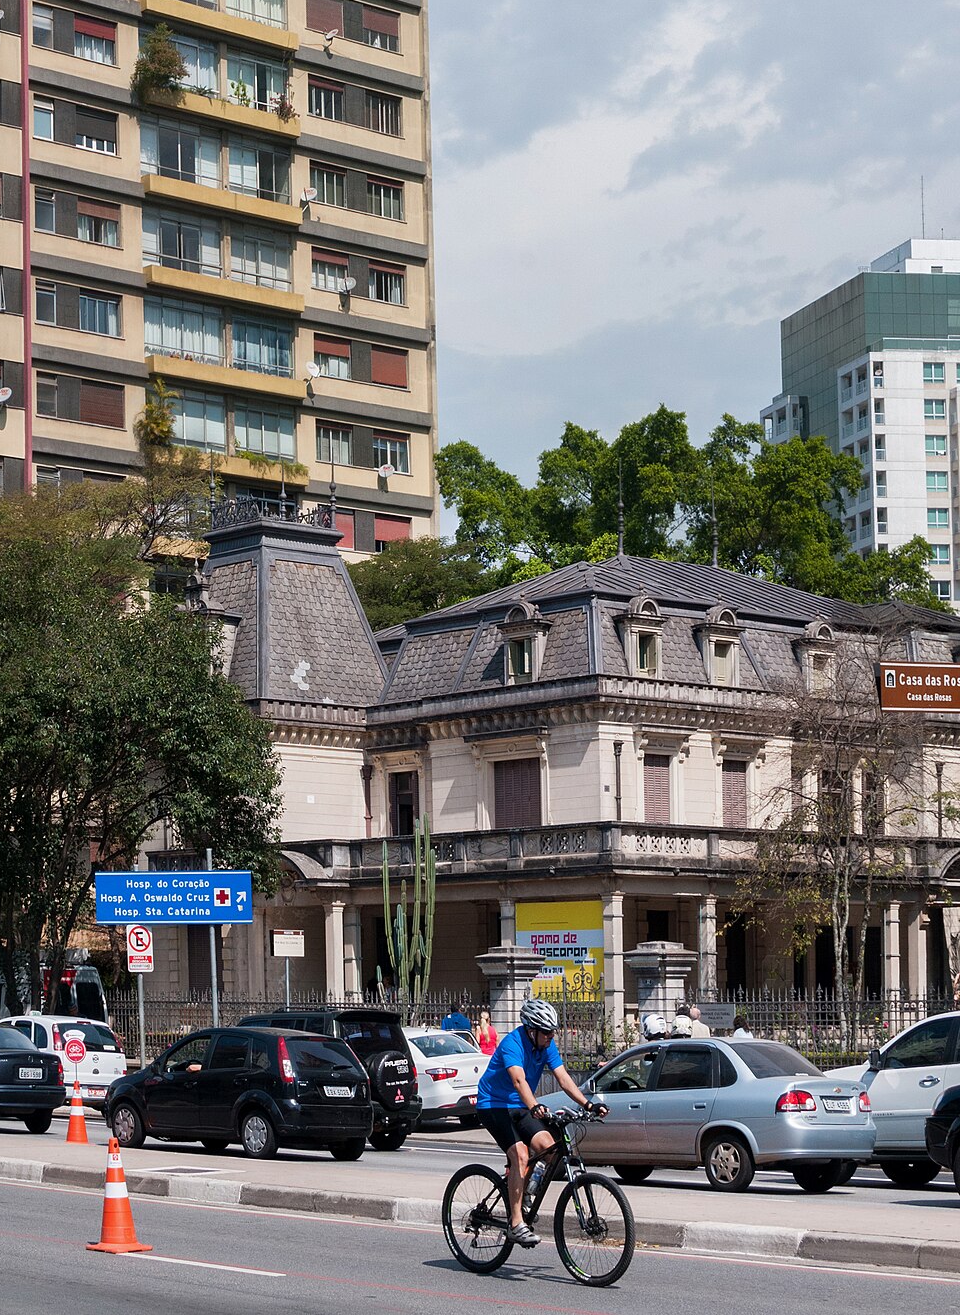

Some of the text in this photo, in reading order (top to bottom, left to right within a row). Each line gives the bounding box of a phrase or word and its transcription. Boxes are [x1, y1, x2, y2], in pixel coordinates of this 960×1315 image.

[899, 673, 923, 686] Casa
[925, 674, 942, 686] das
[907, 692, 952, 702] Casa das Rosas
[126, 879, 210, 890] Hosp. do Coração
[100, 893, 210, 904] Hosp. A. Oswaldo Cruz
[114, 907, 211, 917] Hosp. Sta. Catarina
[136, 931, 143, 946] E
[530, 932, 577, 945] goma de
